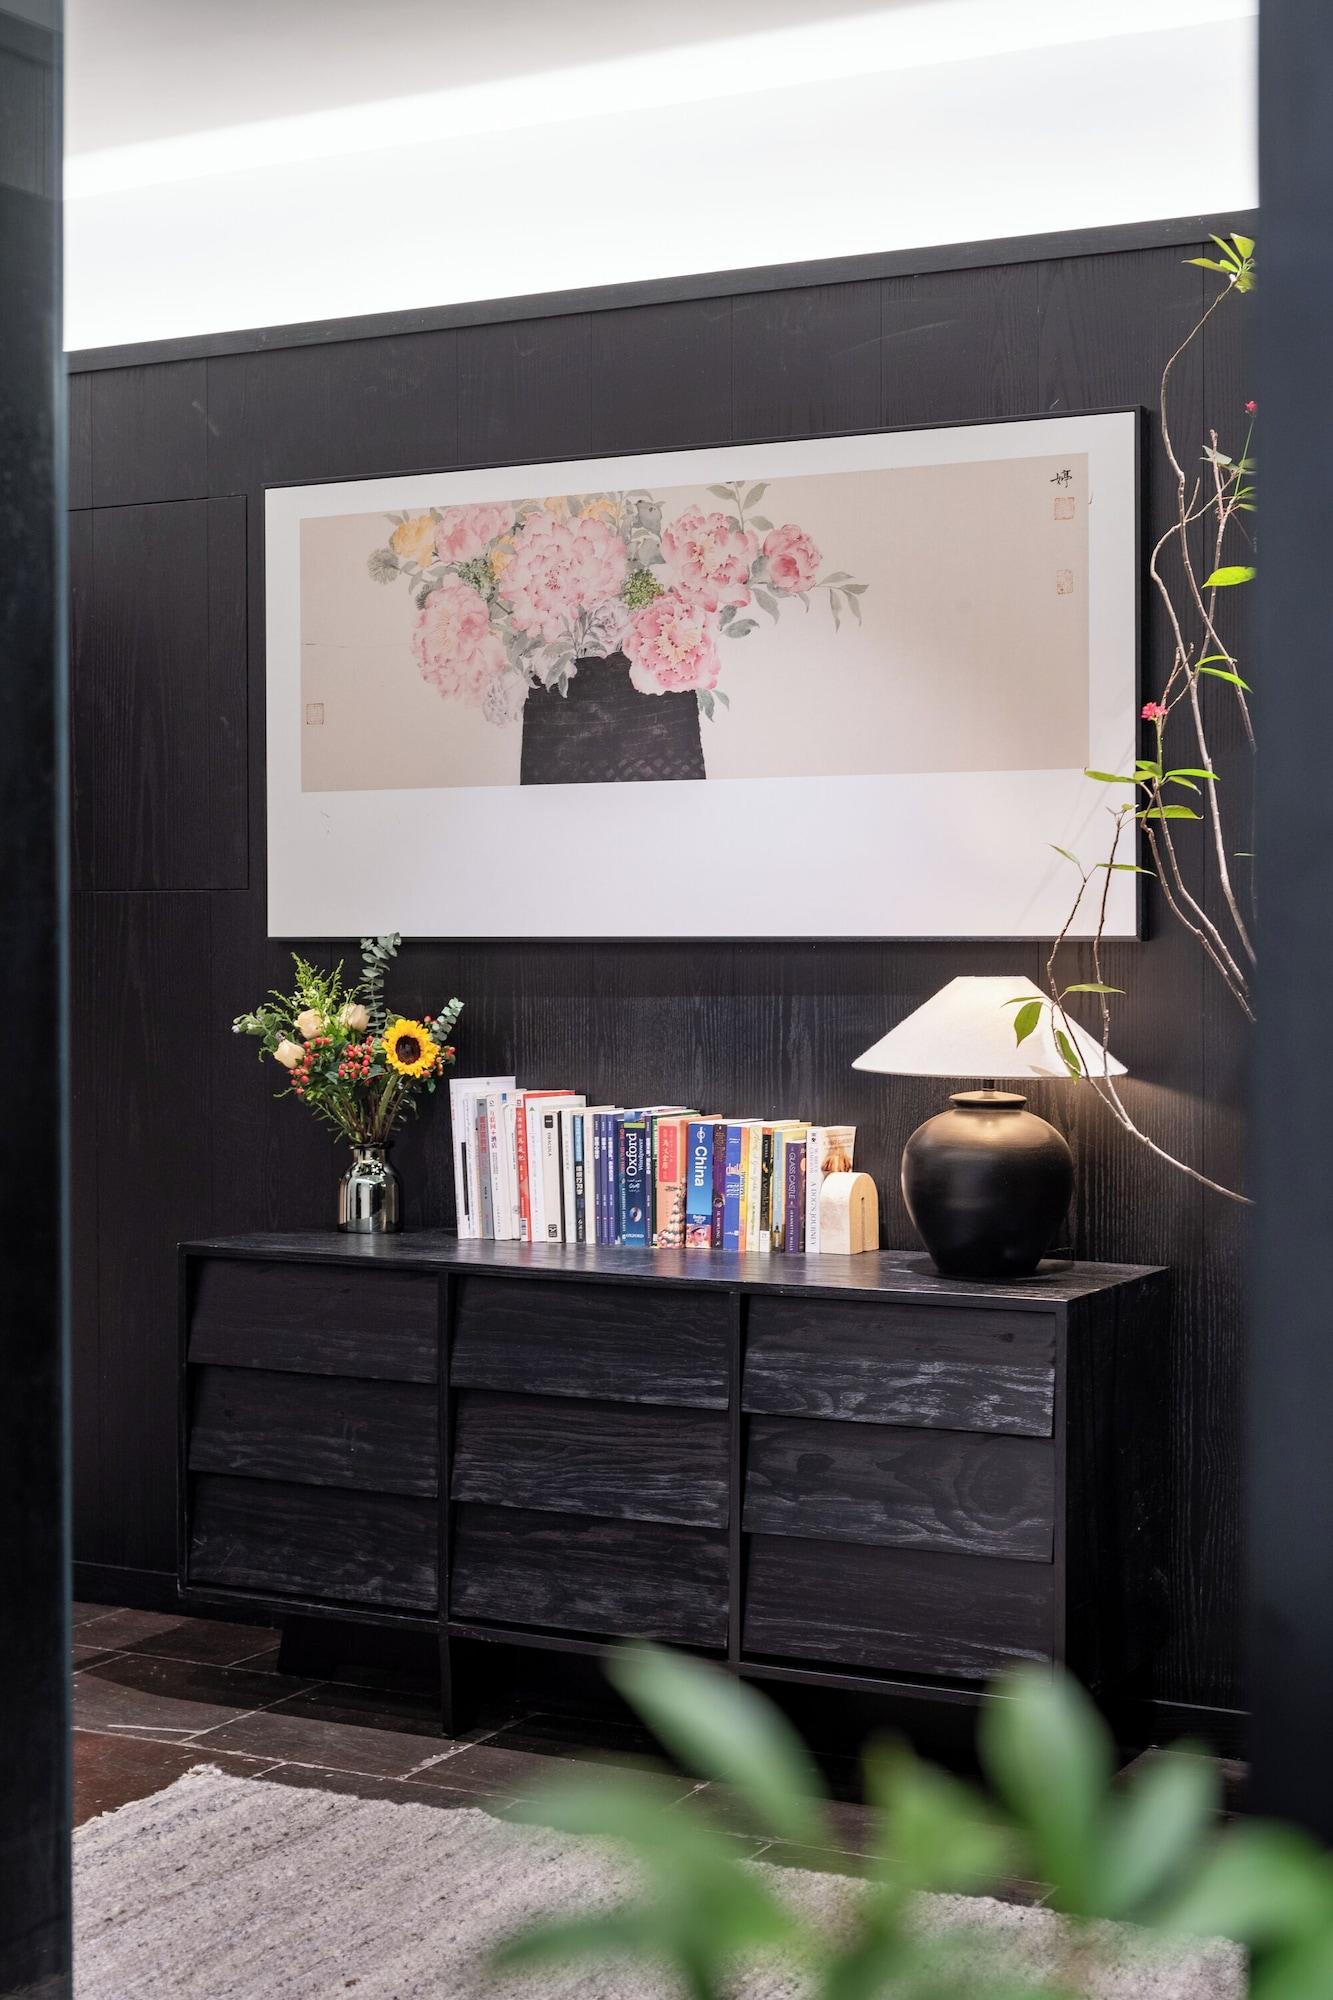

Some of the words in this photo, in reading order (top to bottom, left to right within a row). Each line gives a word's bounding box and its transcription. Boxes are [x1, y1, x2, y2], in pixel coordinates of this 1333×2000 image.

[626, 1133, 637, 1176] Oxford
[694, 1146, 708, 1187] China
[788, 1152, 796, 1174] GLASS
[788, 1175, 796, 1199] CASTLE
